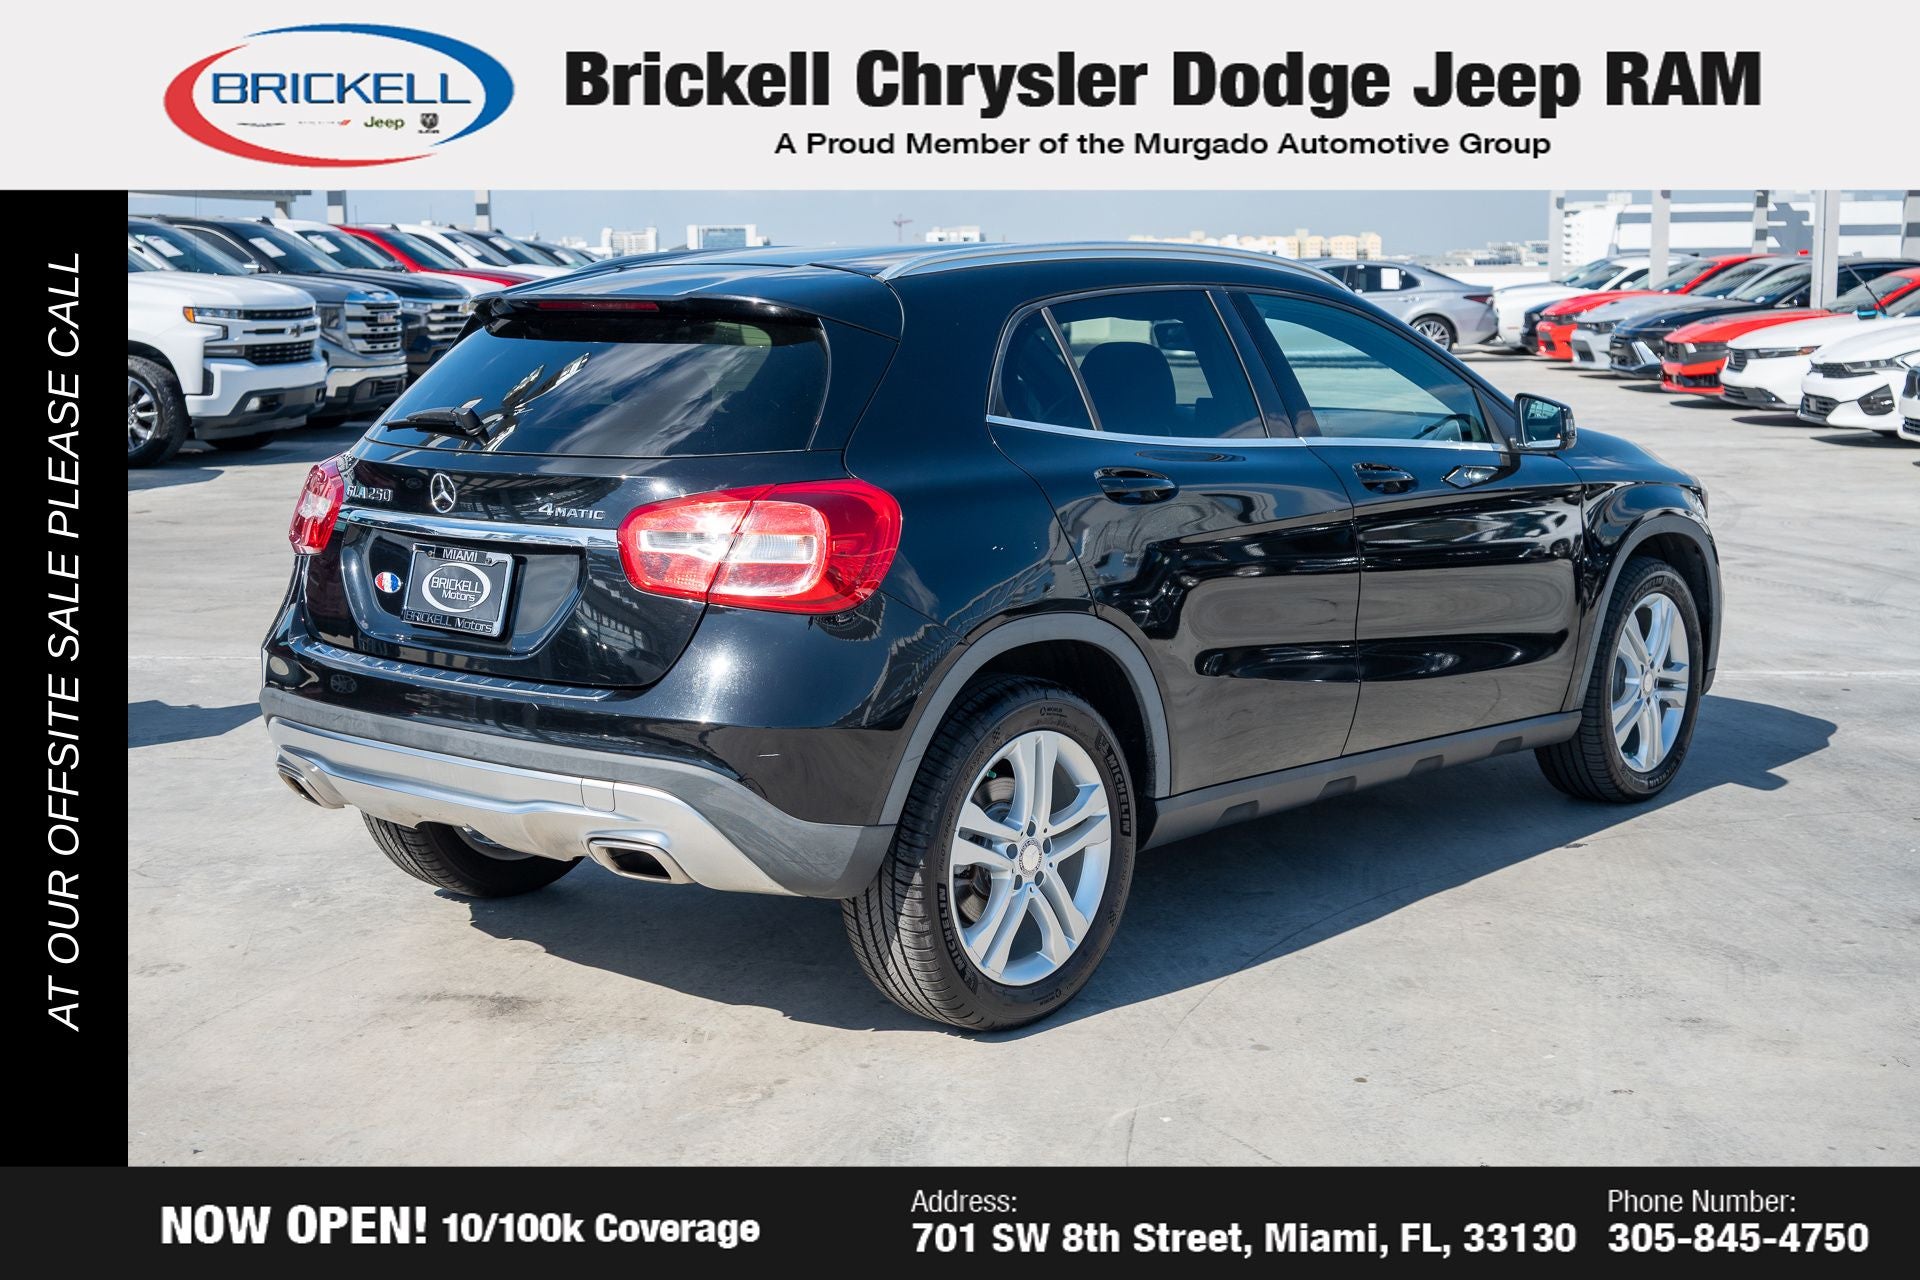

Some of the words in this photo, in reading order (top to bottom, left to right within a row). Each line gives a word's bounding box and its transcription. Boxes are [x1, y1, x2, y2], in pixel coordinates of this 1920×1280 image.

[368, 487, 393, 502] 250
[538, 503, 606, 520] 4MATIC
[442, 548, 478, 564] MIAMI
[431, 576, 482, 594] BRICKELL
[442, 589, 476, 603] Motors
[404, 609, 452, 628] BRICKELL
[454, 617, 494, 634] Motors
[1105, 753, 1131, 836] MICHELIN
[938, 884, 969, 970] MICHELIN
